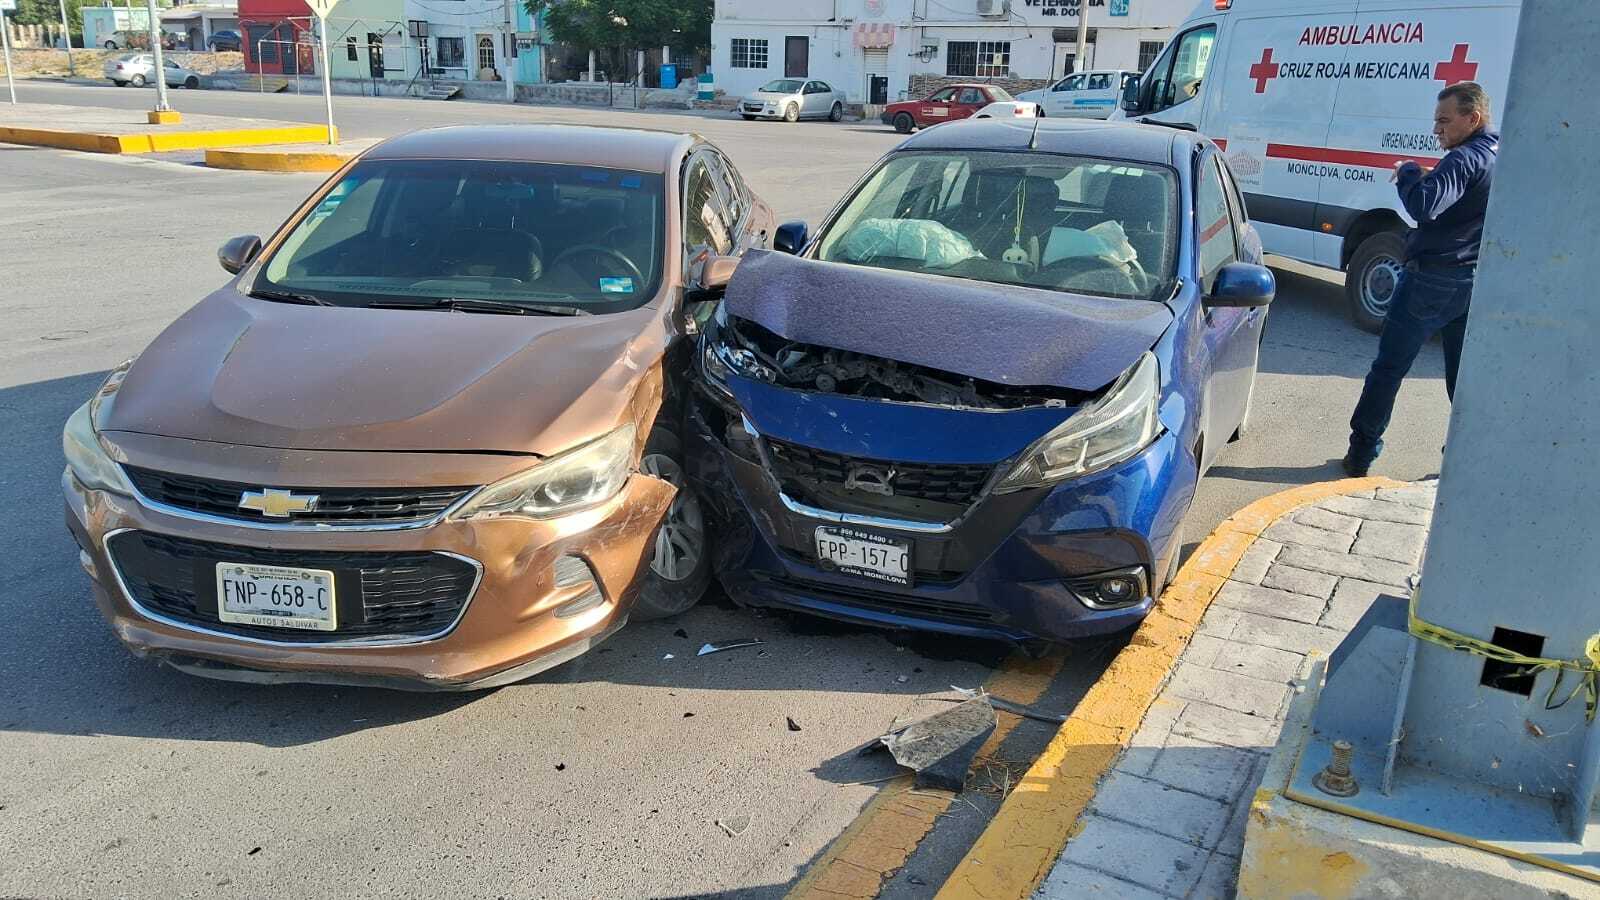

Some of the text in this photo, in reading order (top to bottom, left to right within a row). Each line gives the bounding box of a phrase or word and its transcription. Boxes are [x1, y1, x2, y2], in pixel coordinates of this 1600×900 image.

[1042, 8, 1058, 16] MR.
[1299, 22, 1423, 46] AMBULANCIA
[1279, 62, 1430, 80] CRUZ ROJA MEXICANA
[1381, 132, 1418, 150] URGENCIAS
[1287, 162, 1376, 183] MONCLOVA, COAH.
[863, 571, 907, 584] MONCLOVA
[223, 579, 327, 611] FNP-658-C
[251, 617, 277, 626] AUTOS
